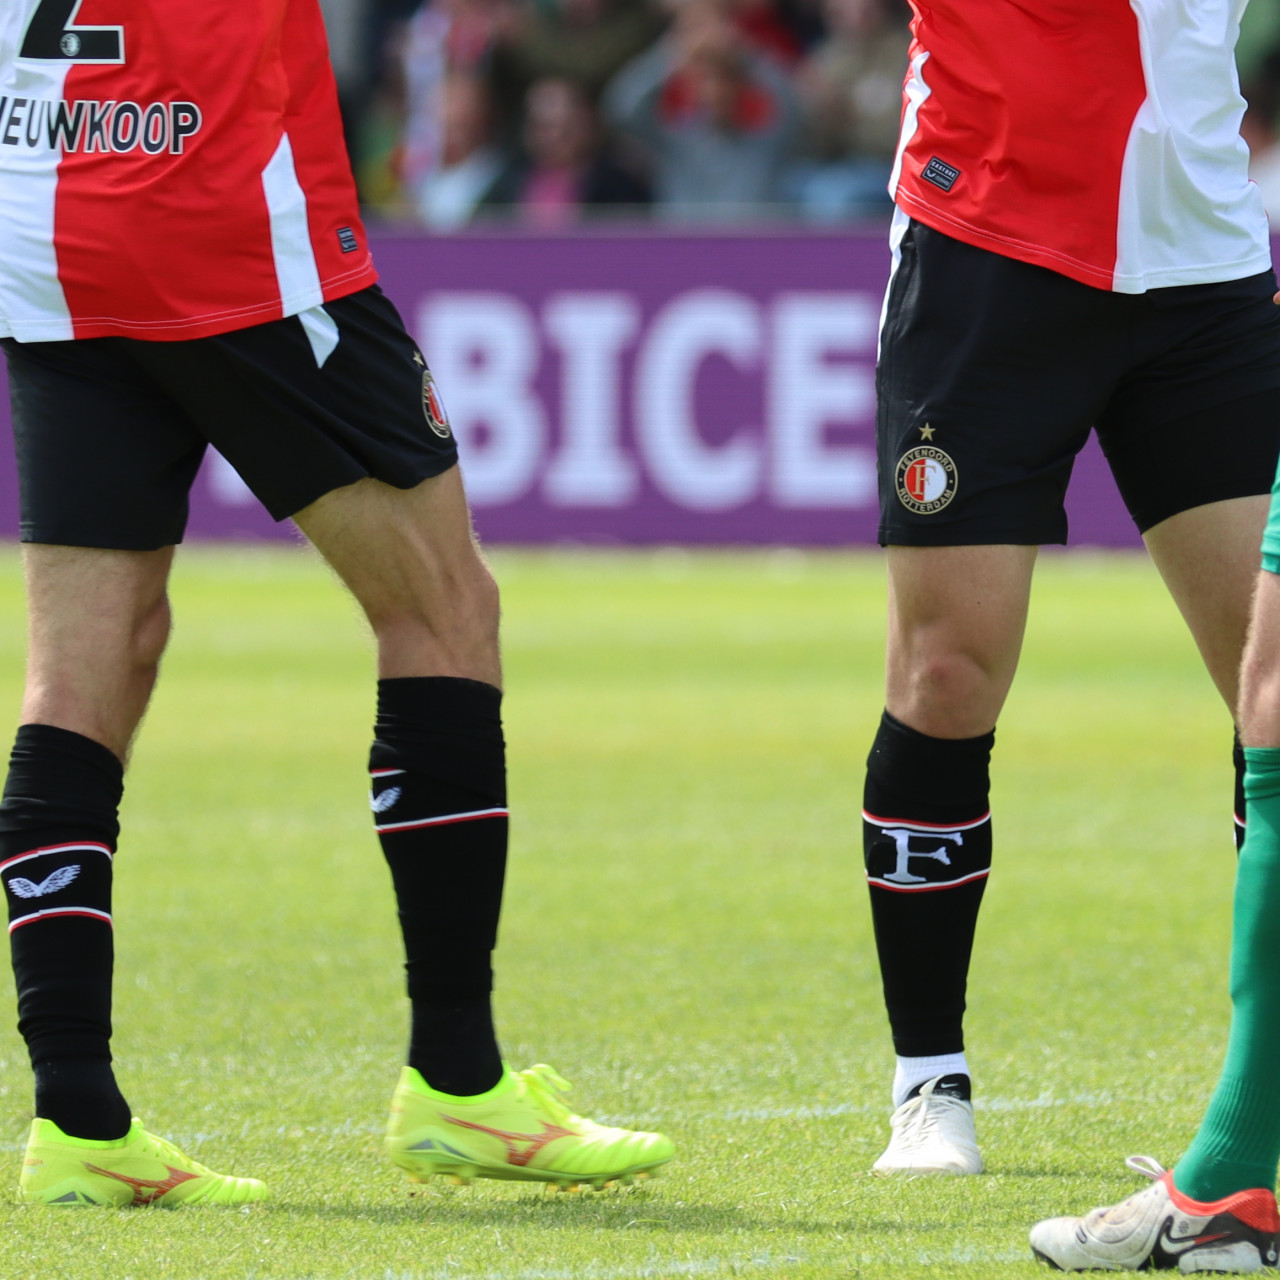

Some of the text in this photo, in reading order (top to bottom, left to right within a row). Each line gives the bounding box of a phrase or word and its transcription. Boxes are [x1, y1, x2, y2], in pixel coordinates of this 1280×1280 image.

[900, 448, 953, 473] FEYENOORD
[899, 487, 953, 513] ROTTERDAM
[881, 828, 964, 883] F
